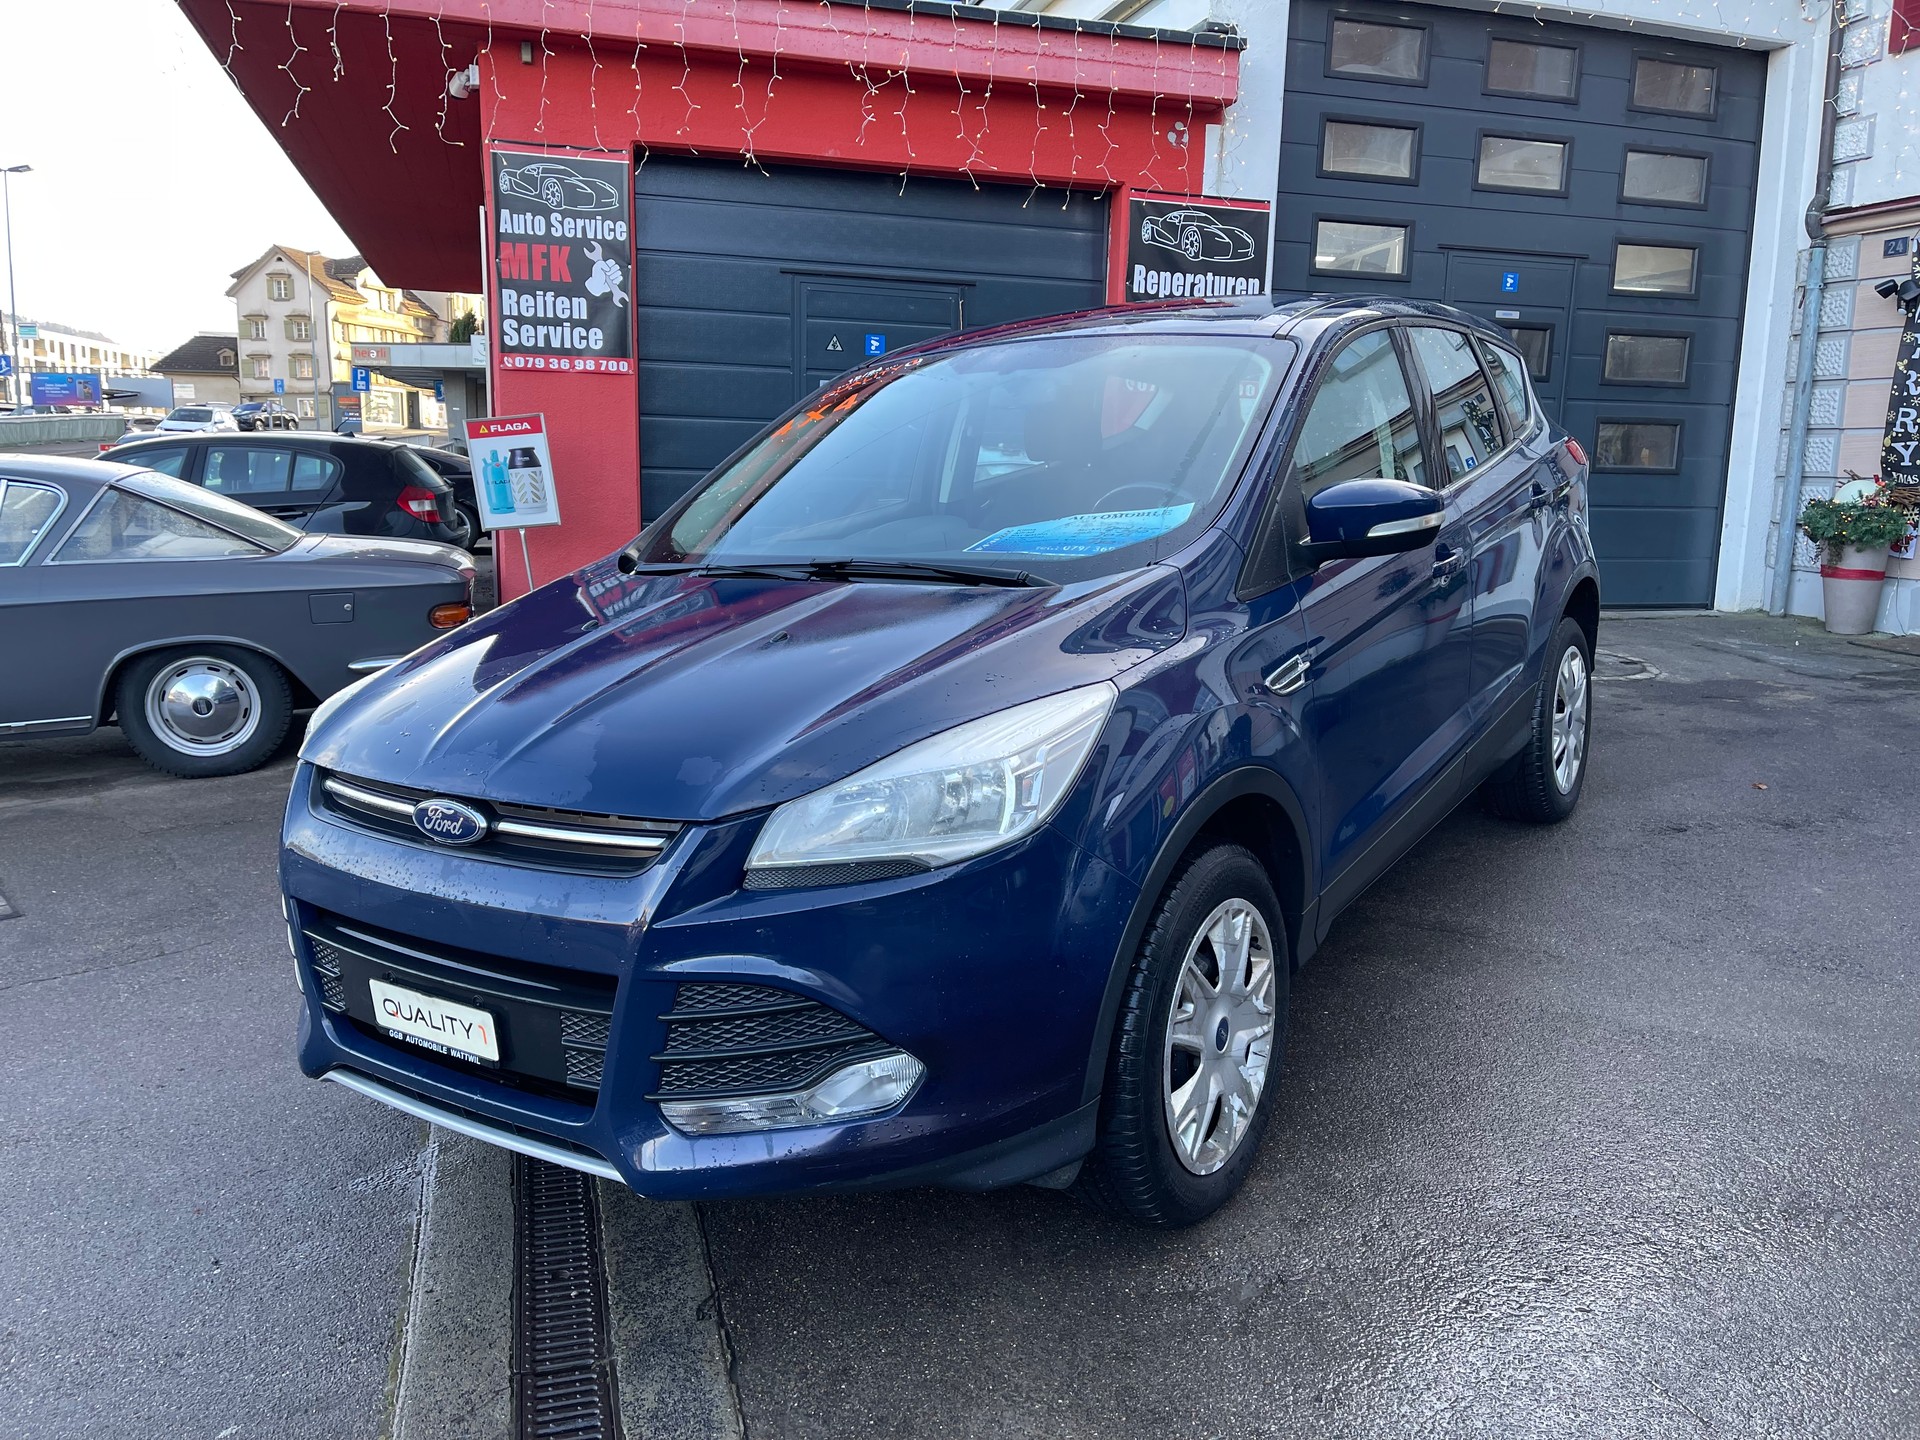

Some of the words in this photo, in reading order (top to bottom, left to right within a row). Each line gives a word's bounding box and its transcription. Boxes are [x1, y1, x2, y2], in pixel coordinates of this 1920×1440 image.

[500, 209, 546, 236] Auto
[550, 213, 627, 241] Service
[500, 242, 572, 283] MFK
[1888, 241, 1903, 255] 24
[1133, 264, 1260, 298] Reperaturen
[502, 289, 588, 320] Reifen
[502, 319, 604, 350] Service
[357, 369, 366, 380] P
[514, 357, 545, 368] 079
[549, 358, 570, 370] 36
[574, 359, 595, 371] 98
[599, 360, 629, 372] 700
[490, 422, 531, 433] FLAGA
[423, 805, 464, 835] Ford
[383, 998, 473, 1040] QUALITY
[389, 1029, 403, 1040] GGB
[405, 1034, 448, 1055] AUTOMOBILE
[450, 1049, 481, 1065] WATTWIL
